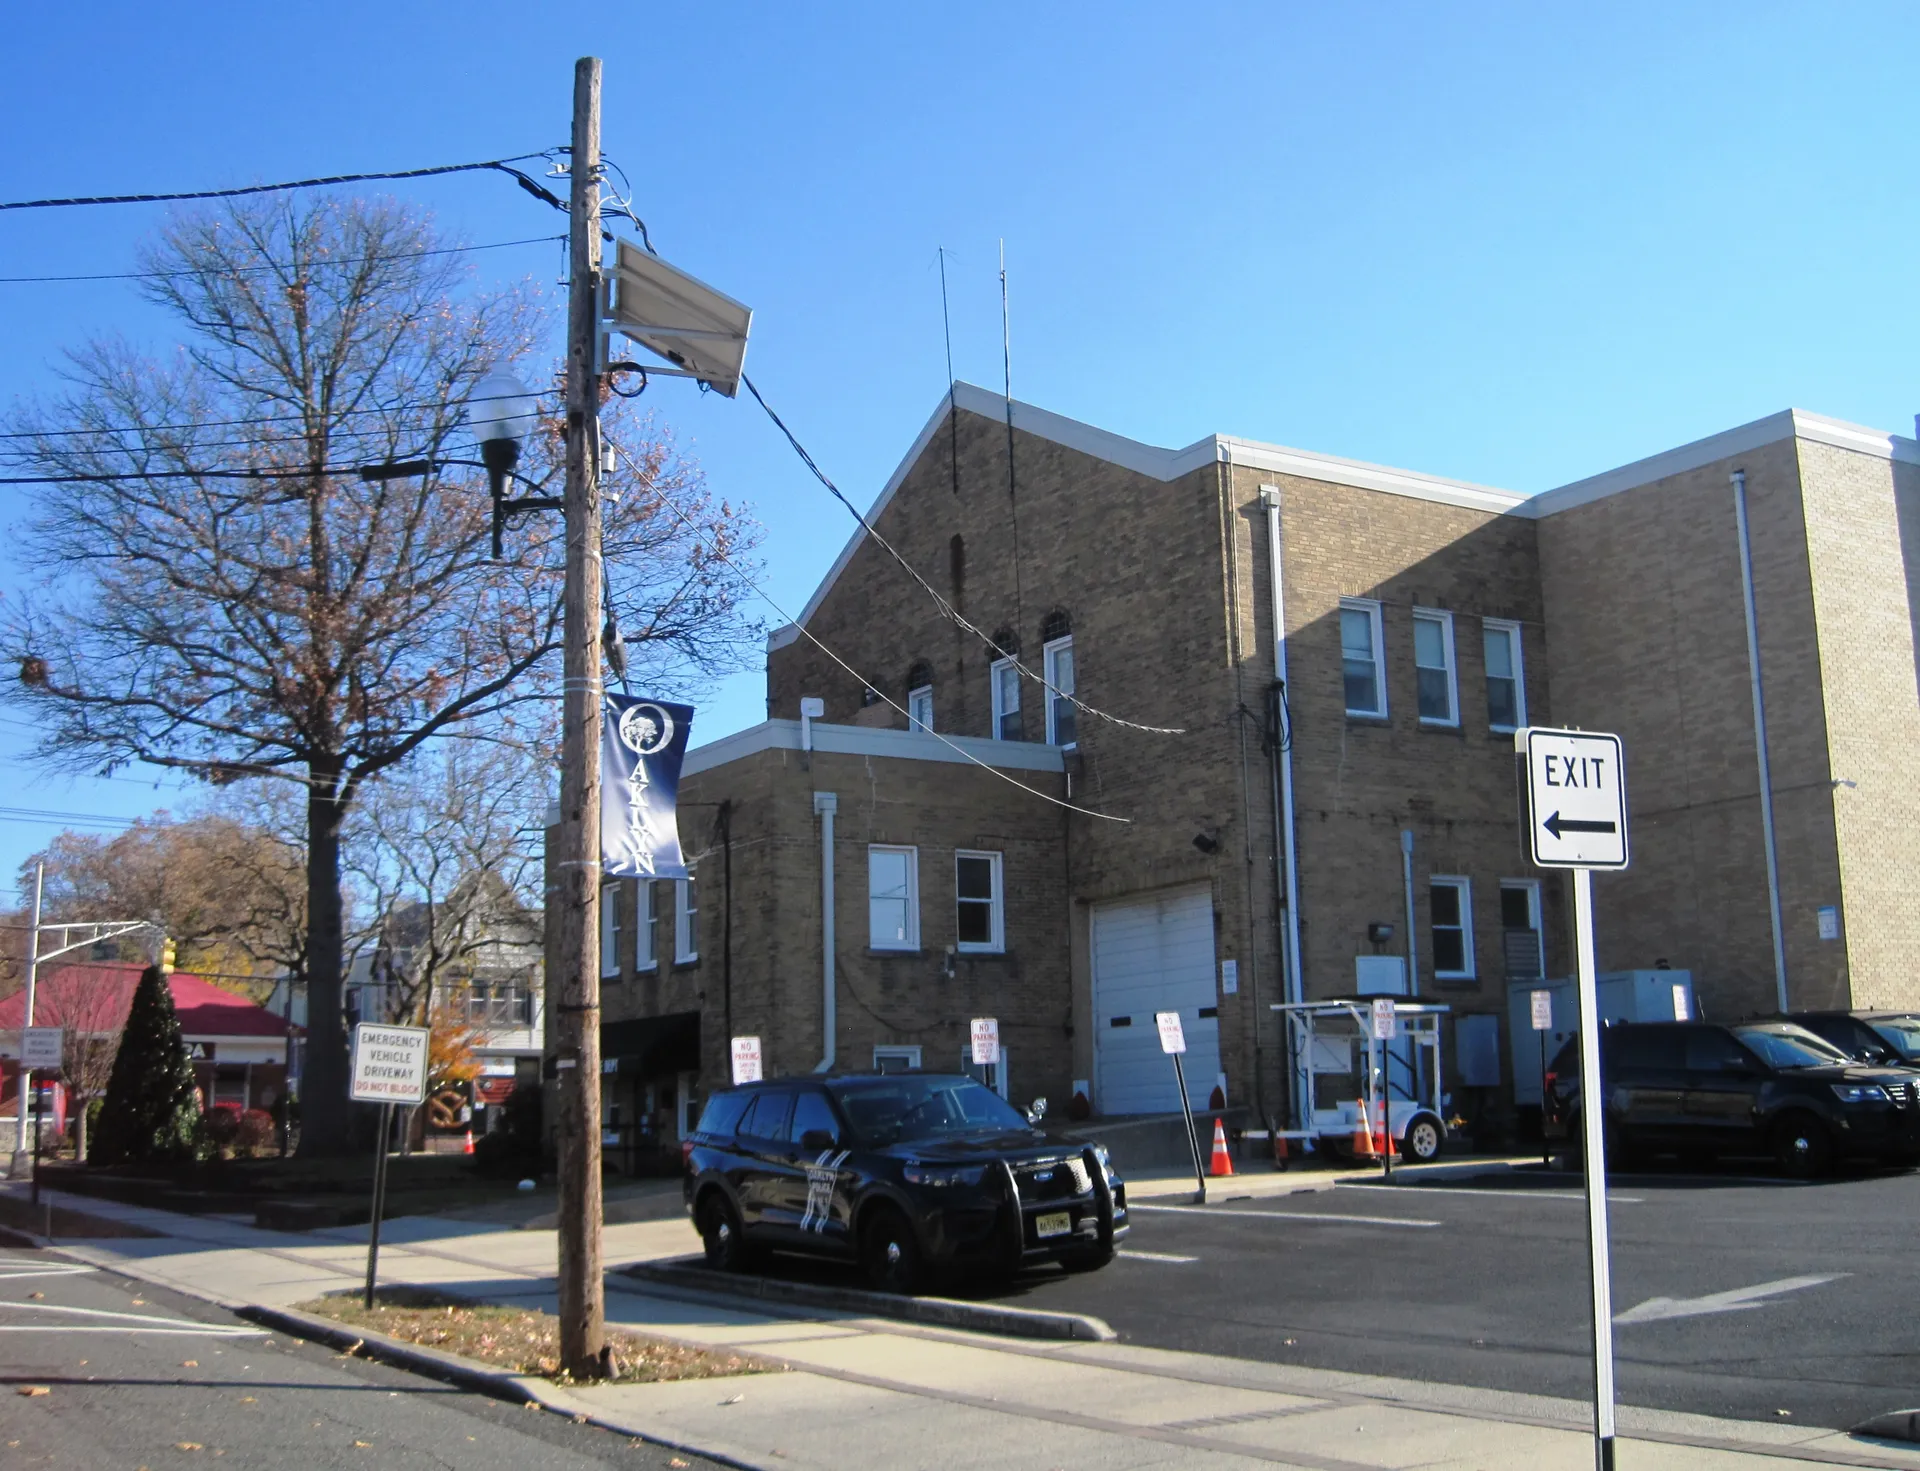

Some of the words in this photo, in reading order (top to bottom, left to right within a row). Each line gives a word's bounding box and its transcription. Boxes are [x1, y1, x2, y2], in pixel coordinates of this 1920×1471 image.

[1545, 754, 1604, 789] EXIT
[618, 703, 675, 875] OAKLYN
[979, 1023, 990, 1032] NO
[361, 1032, 422, 1048] EMERGENCY
[973, 1033, 996, 1041] PARKING
[740, 1042, 752, 1051] NO
[370, 1049, 412, 1063] VEHICLE
[735, 1052, 760, 1060] PARKING
[364, 1065, 414, 1079] DRIVEWAY
[356, 1080, 368, 1091] DO
[370, 1083, 388, 1093] NOT
[390, 1084, 419, 1095] BLOCK
